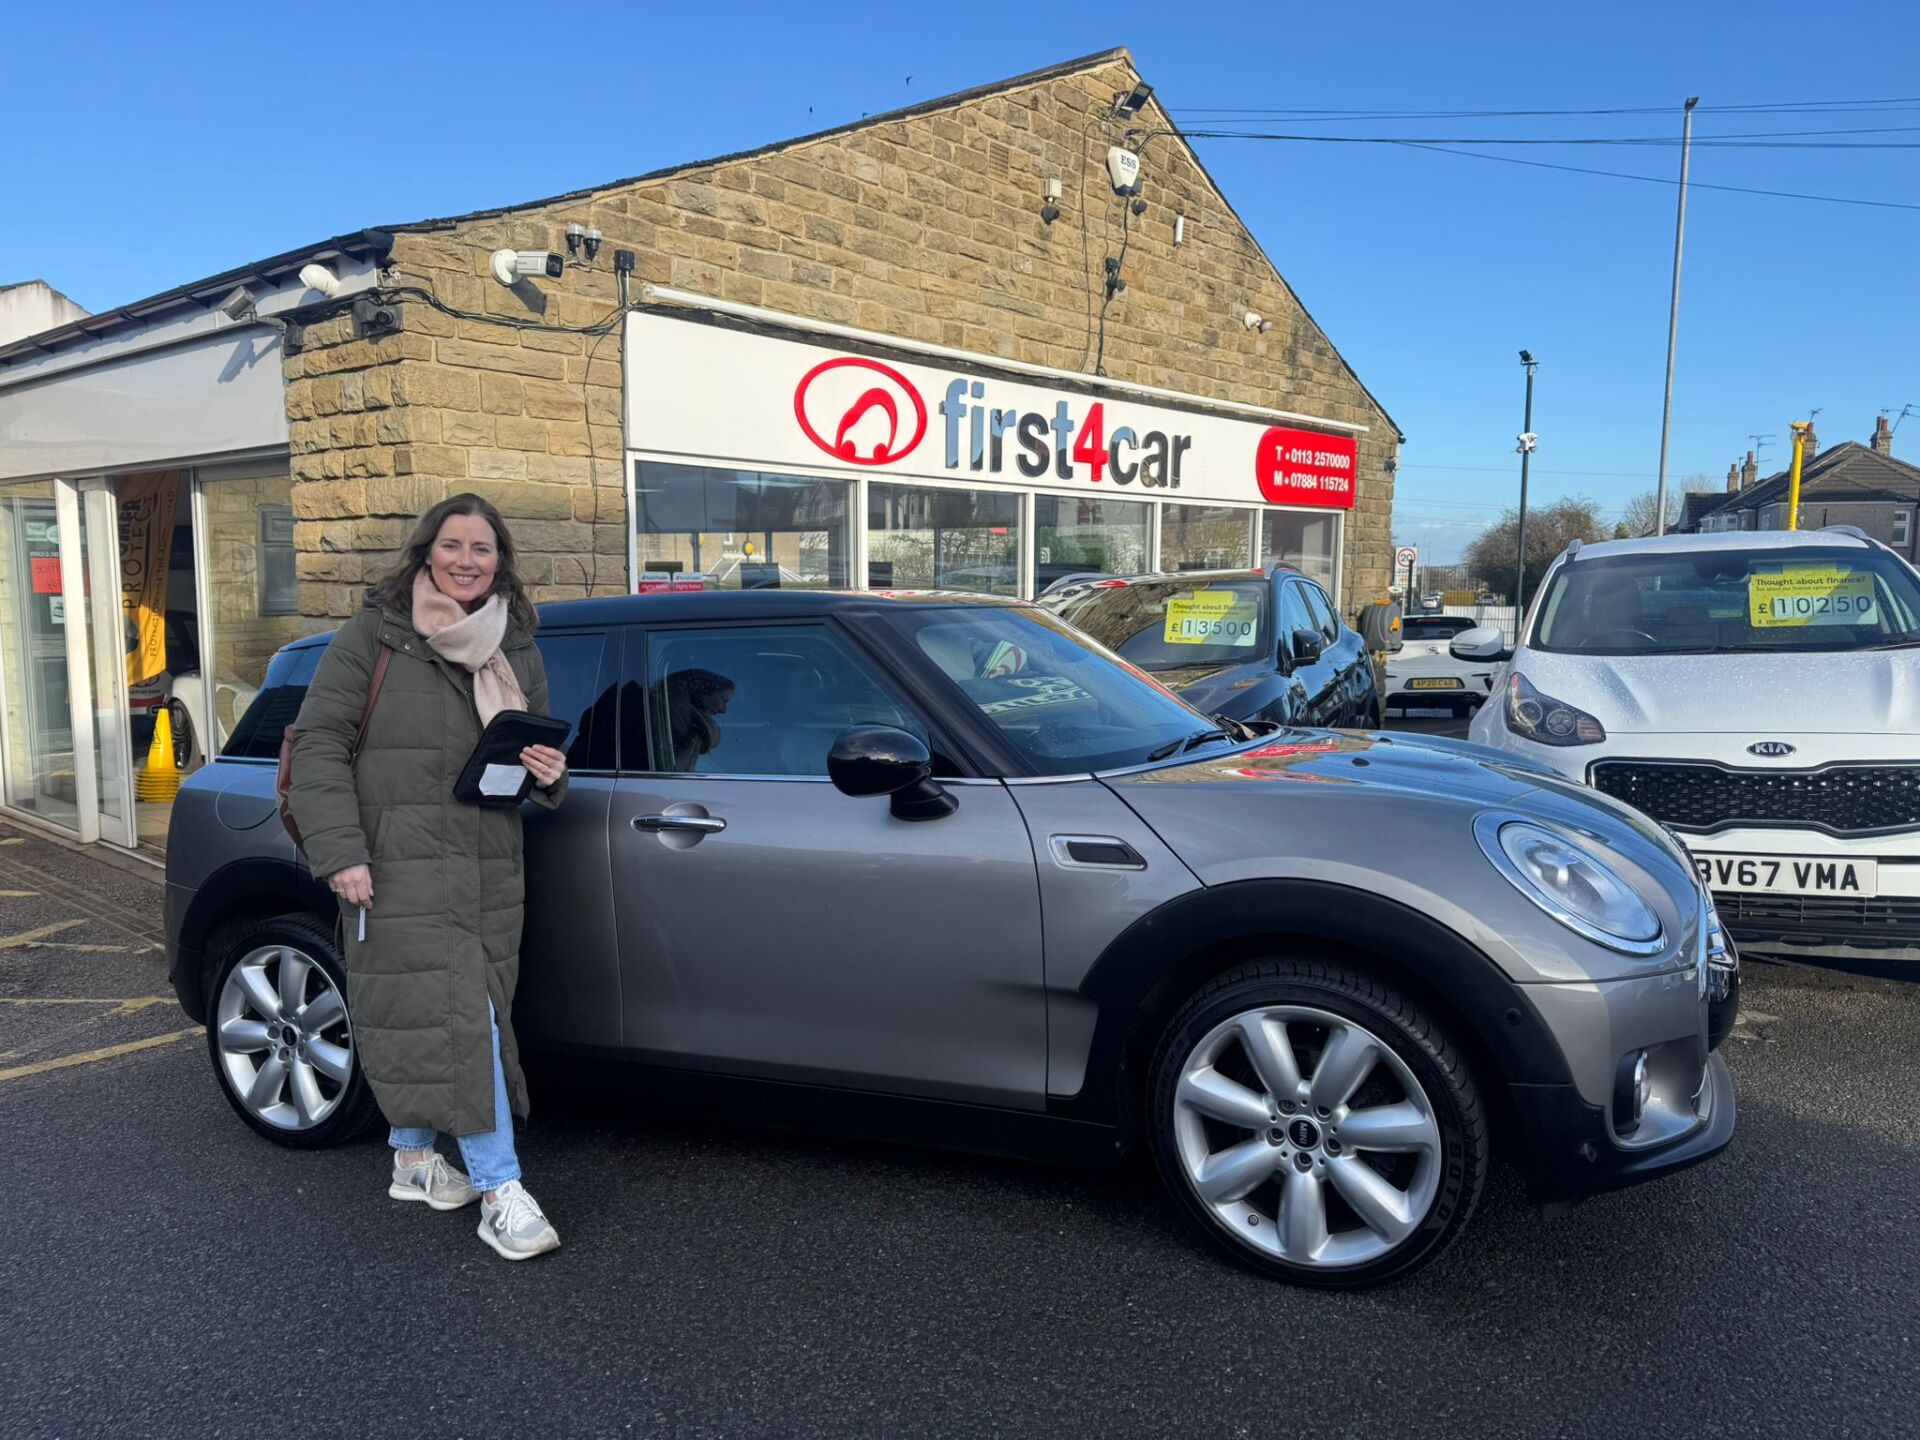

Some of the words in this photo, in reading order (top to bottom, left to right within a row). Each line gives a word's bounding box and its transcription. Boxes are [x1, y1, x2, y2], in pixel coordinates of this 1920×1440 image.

[940, 378, 1191, 489] first4car
[1275, 446, 1283, 461] T
[1291, 448, 1313, 465] 0113
[1314, 452, 1350, 469] 2570000
[1273, 470, 1283, 486] M
[1290, 472, 1318, 489] 07884
[1319, 475, 1349, 492] 115724
[1757, 579, 1794, 587] Thought
[1796, 577, 1822, 585] about
[1826, 576, 1866, 584] finance?
[1173, 602, 1200, 610] Thought
[1758, 603, 1768, 614] £
[1777, 595, 1871, 614] 10250
[1171, 622, 1179, 633] £
[1186, 619, 1252, 637] 13500
[1754, 743, 1789, 754] KIA
[1792, 862, 1860, 892] VMA
[1299, 1122, 1308, 1145] MINI
